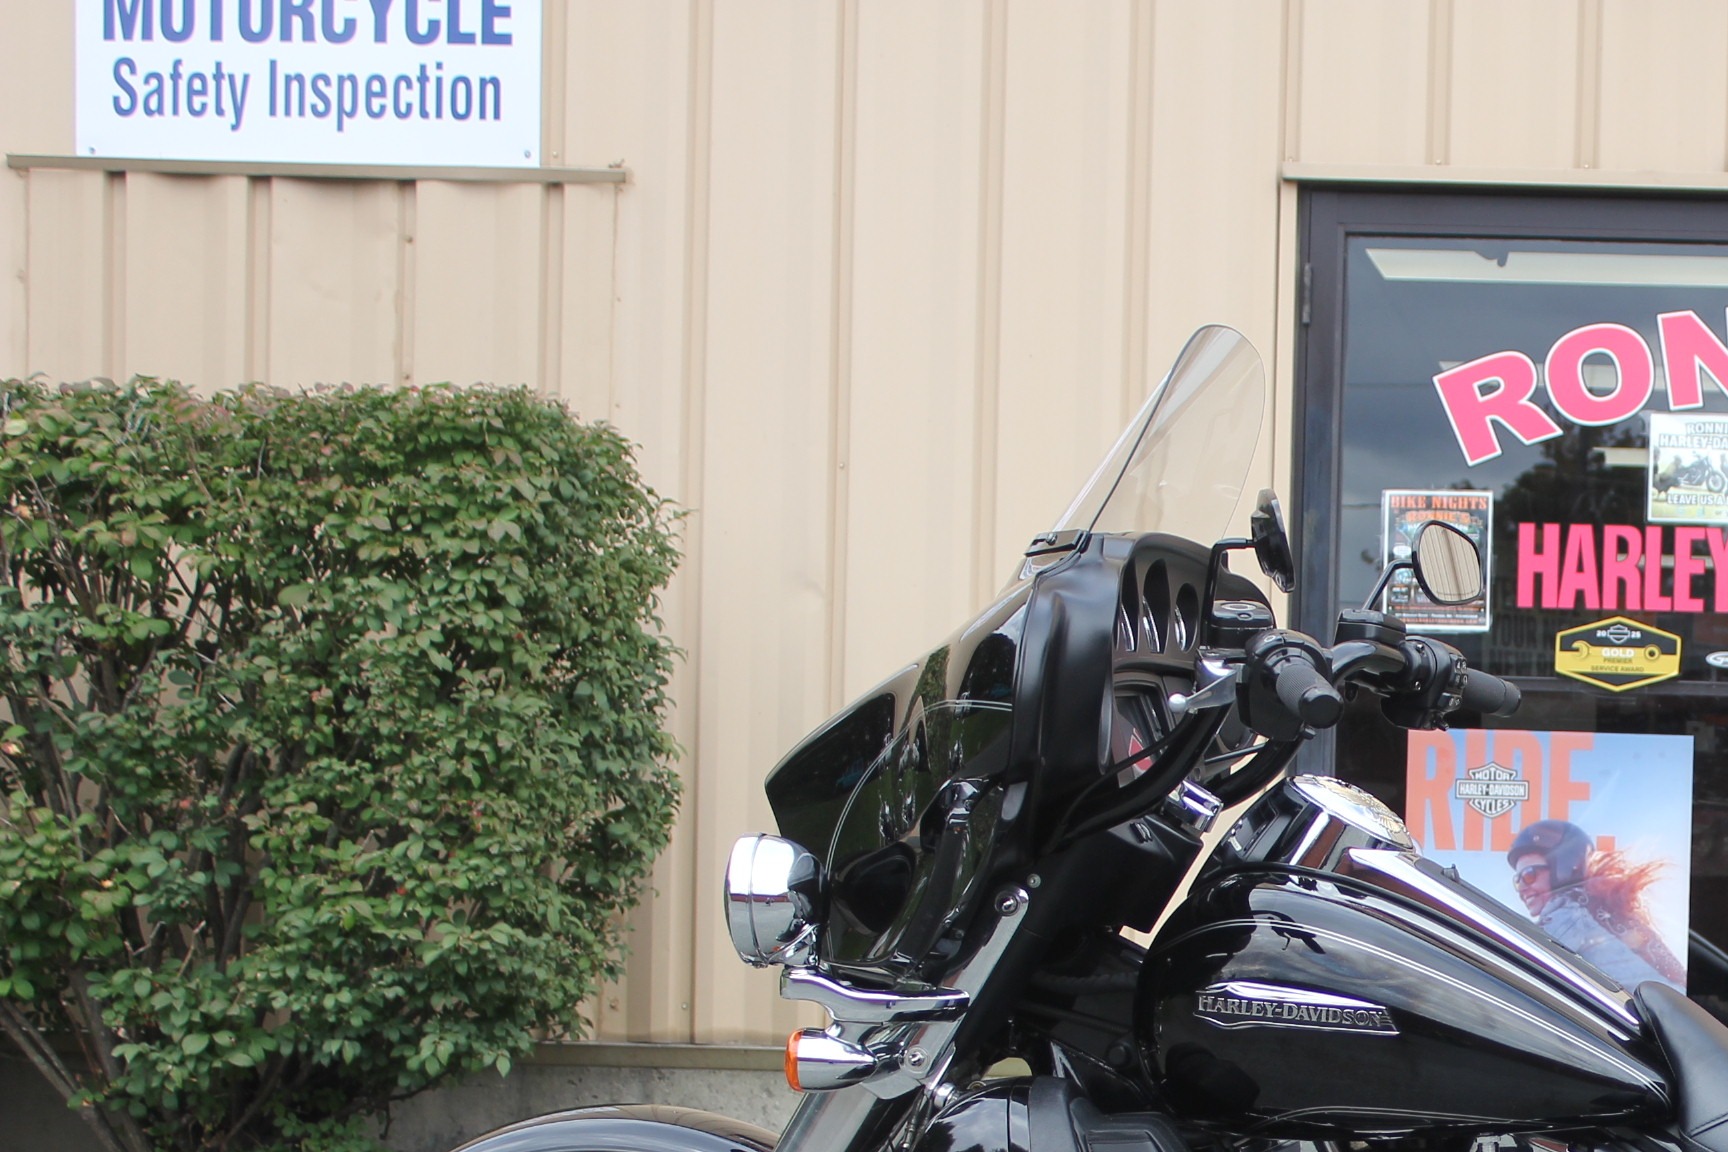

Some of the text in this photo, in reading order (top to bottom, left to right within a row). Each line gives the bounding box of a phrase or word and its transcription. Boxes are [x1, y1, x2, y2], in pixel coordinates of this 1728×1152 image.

[101, 0, 514, 46] MOTORCYCLE
[112, 57, 502, 132] Safety Inspection
[1391, 495, 1487, 509] BIKE NIGHTS
[1667, 493, 1697, 505] LEAVE
[1700, 495, 1714, 505] US
[1715, 495, 1724, 505] A
[1596, 629, 1606, 638] 20
[1602, 648, 1635, 658] GOLD
[1475, 767, 1510, 780] MOTOR
[1459, 783, 1525, 796] HARLEY-DAVIDSON
[1474, 798, 1510, 814] CYCLES
[1198, 995, 1383, 1028] HARLEY-DAVIDSON
